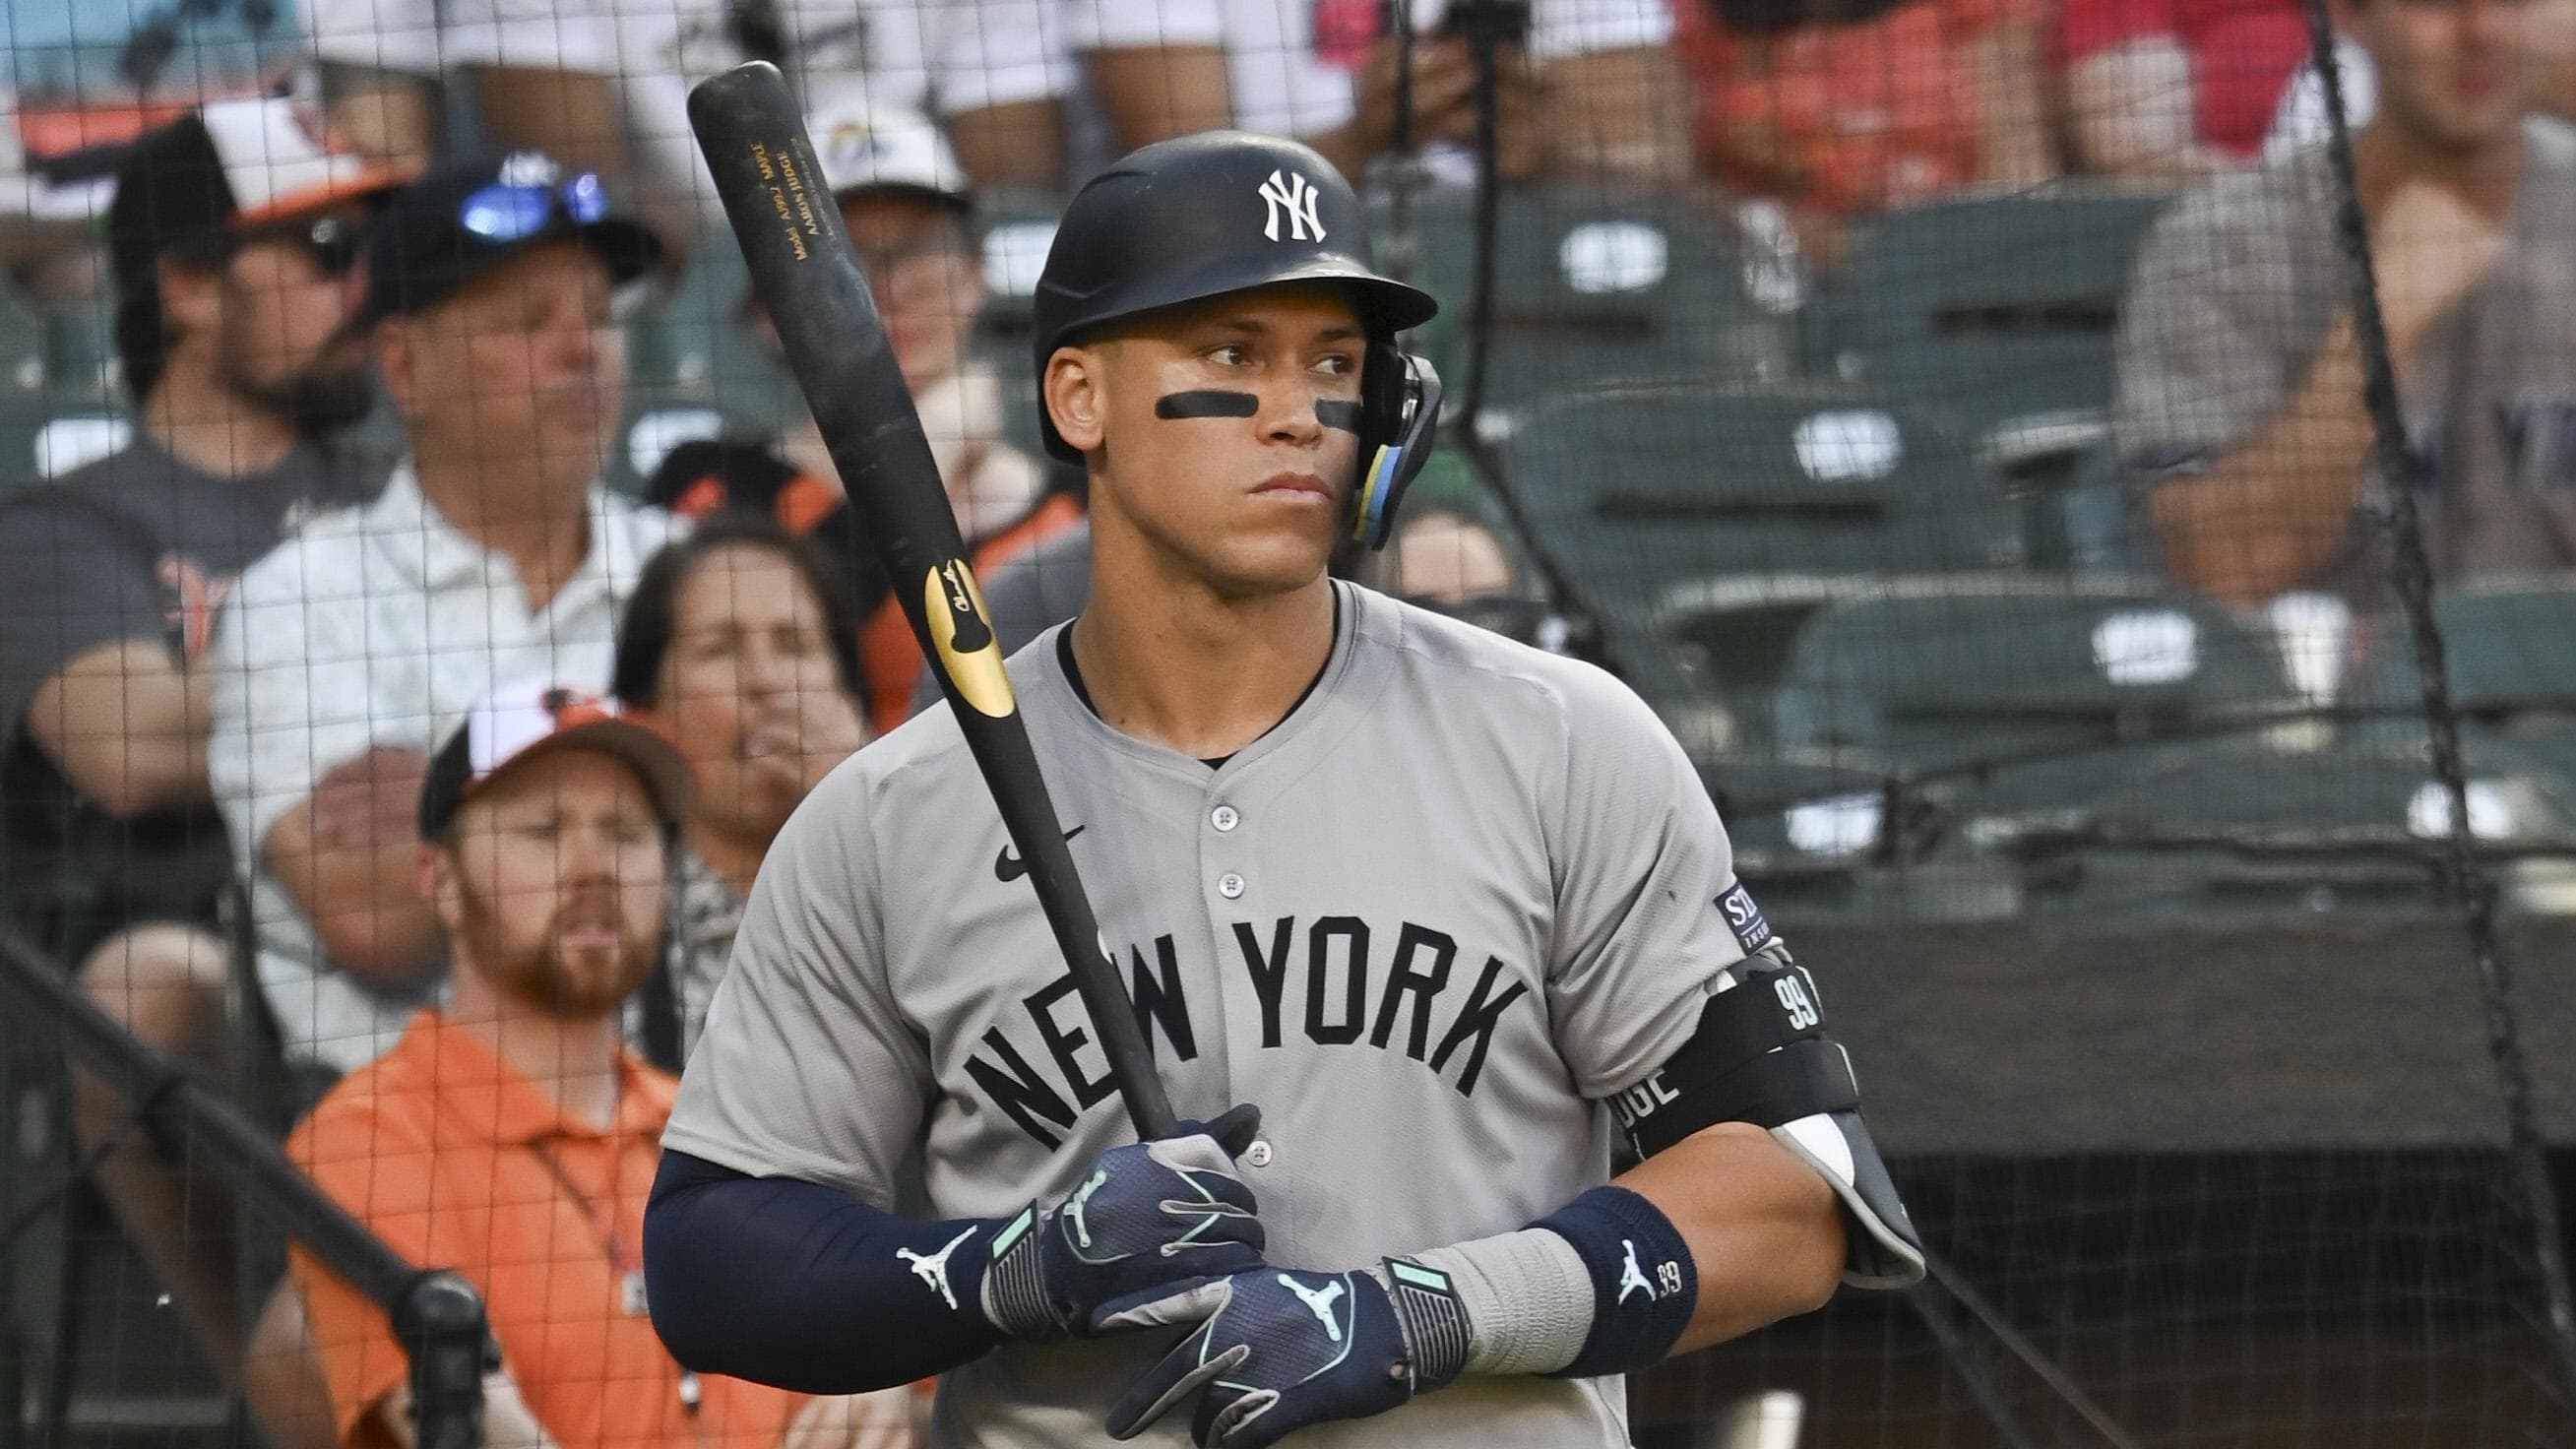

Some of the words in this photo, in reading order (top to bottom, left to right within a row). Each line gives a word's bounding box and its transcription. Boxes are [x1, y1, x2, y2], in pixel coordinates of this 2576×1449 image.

[750, 141, 774, 180] MAPLE
[776, 151, 803, 191] JUDGE
[793, 192, 820, 235] AARON
[1258, 169, 1327, 243] NY
[785, 226, 808, 261] Model
[1774, 975, 1819, 1031] 99
[963, 933, 1198, 1153] NEW
[1231, 915, 1529, 1098] YORK
